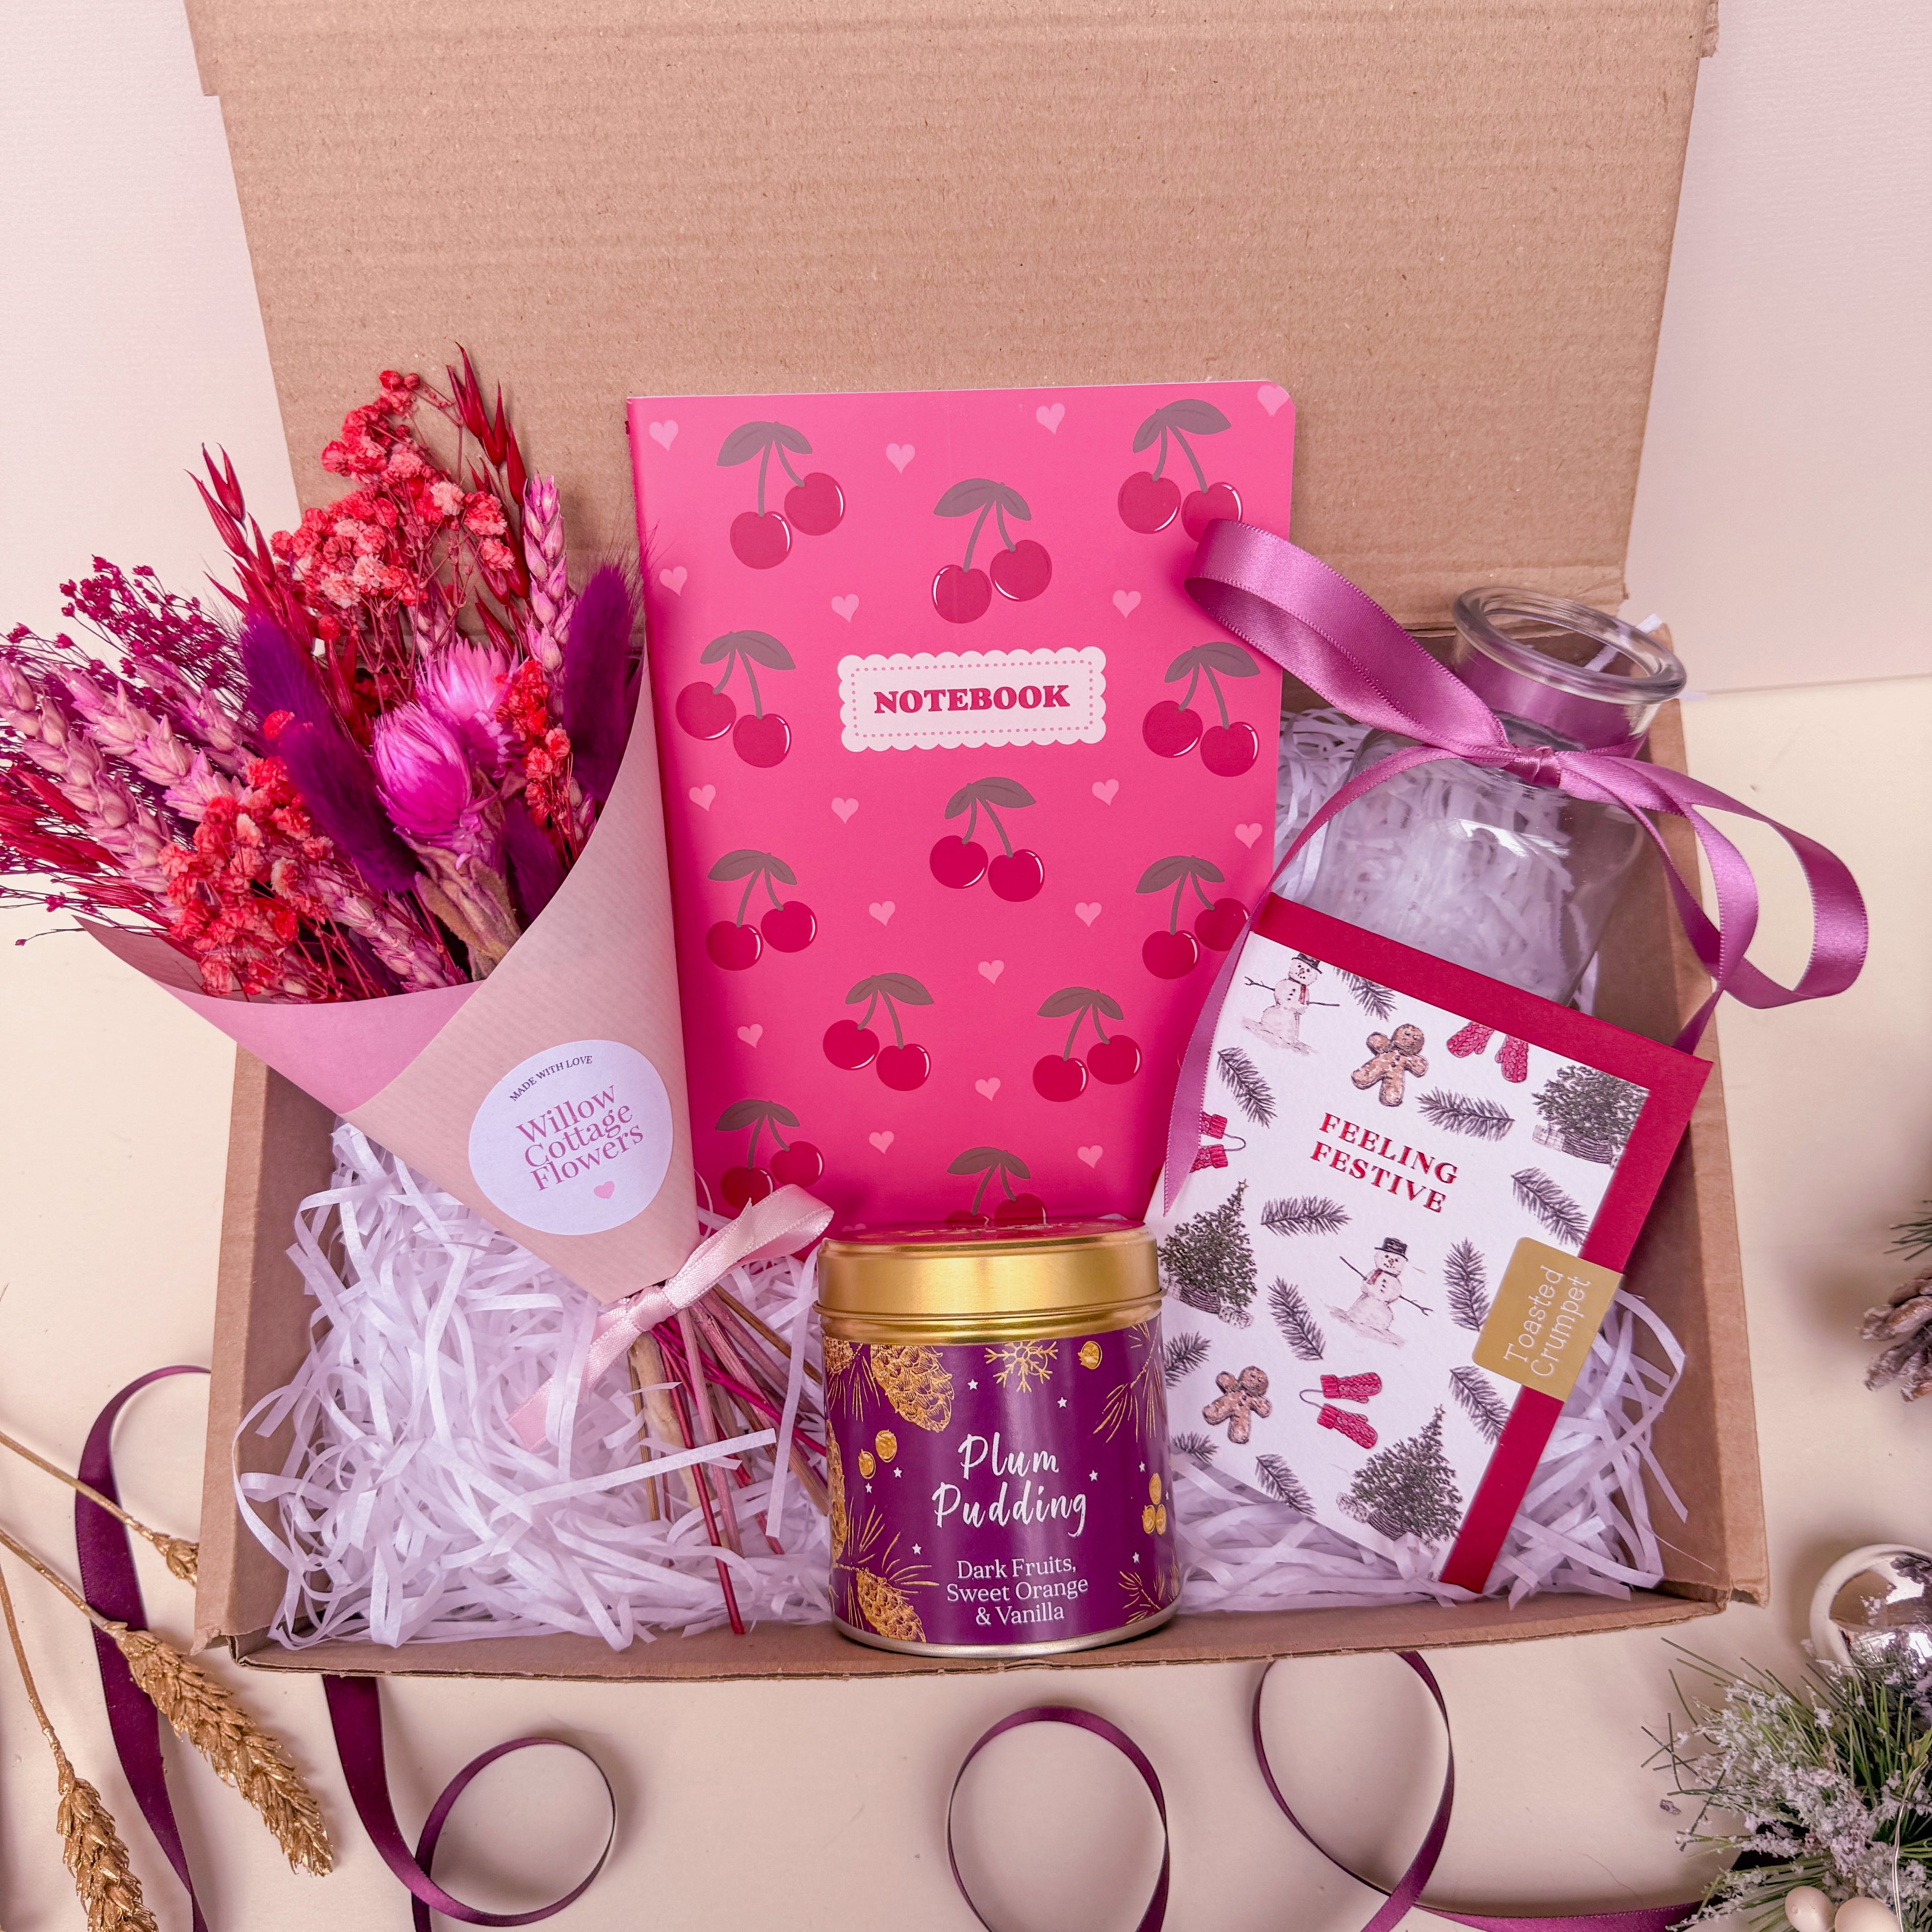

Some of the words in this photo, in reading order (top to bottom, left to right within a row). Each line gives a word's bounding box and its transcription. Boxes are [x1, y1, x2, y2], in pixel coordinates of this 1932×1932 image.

[873, 685, 1070, 713] NOTEBOOK
[509, 1077, 537, 1101] MADE
[536, 1062, 564, 1079] WITH
[566, 1056, 593, 1068] LOVE
[516, 1085, 614, 1143] Willow
[525, 1105, 633, 1167] Cottage
[530, 1124, 643, 1191] Flowers
[1310, 1141, 1446, 1213] FESTIVE
[1319, 1112, 1458, 1184] FEELING
[1503, 1264, 1564, 1362] Toasted
[1530, 1276, 1592, 1377] Crumpet
[957, 1431, 1059, 1480] Plum
[931, 1480, 1086, 1538] Pudding
[946, 1583, 1010, 1602] Sweet
[1015, 1578, 1088, 1599] Orange
[957, 1559, 1008, 1580] Dark
[1012, 1556, 1076, 1578] Fruits,
[975, 1606, 992, 1626] &
[994, 1601, 1065, 1625] Vanilla
